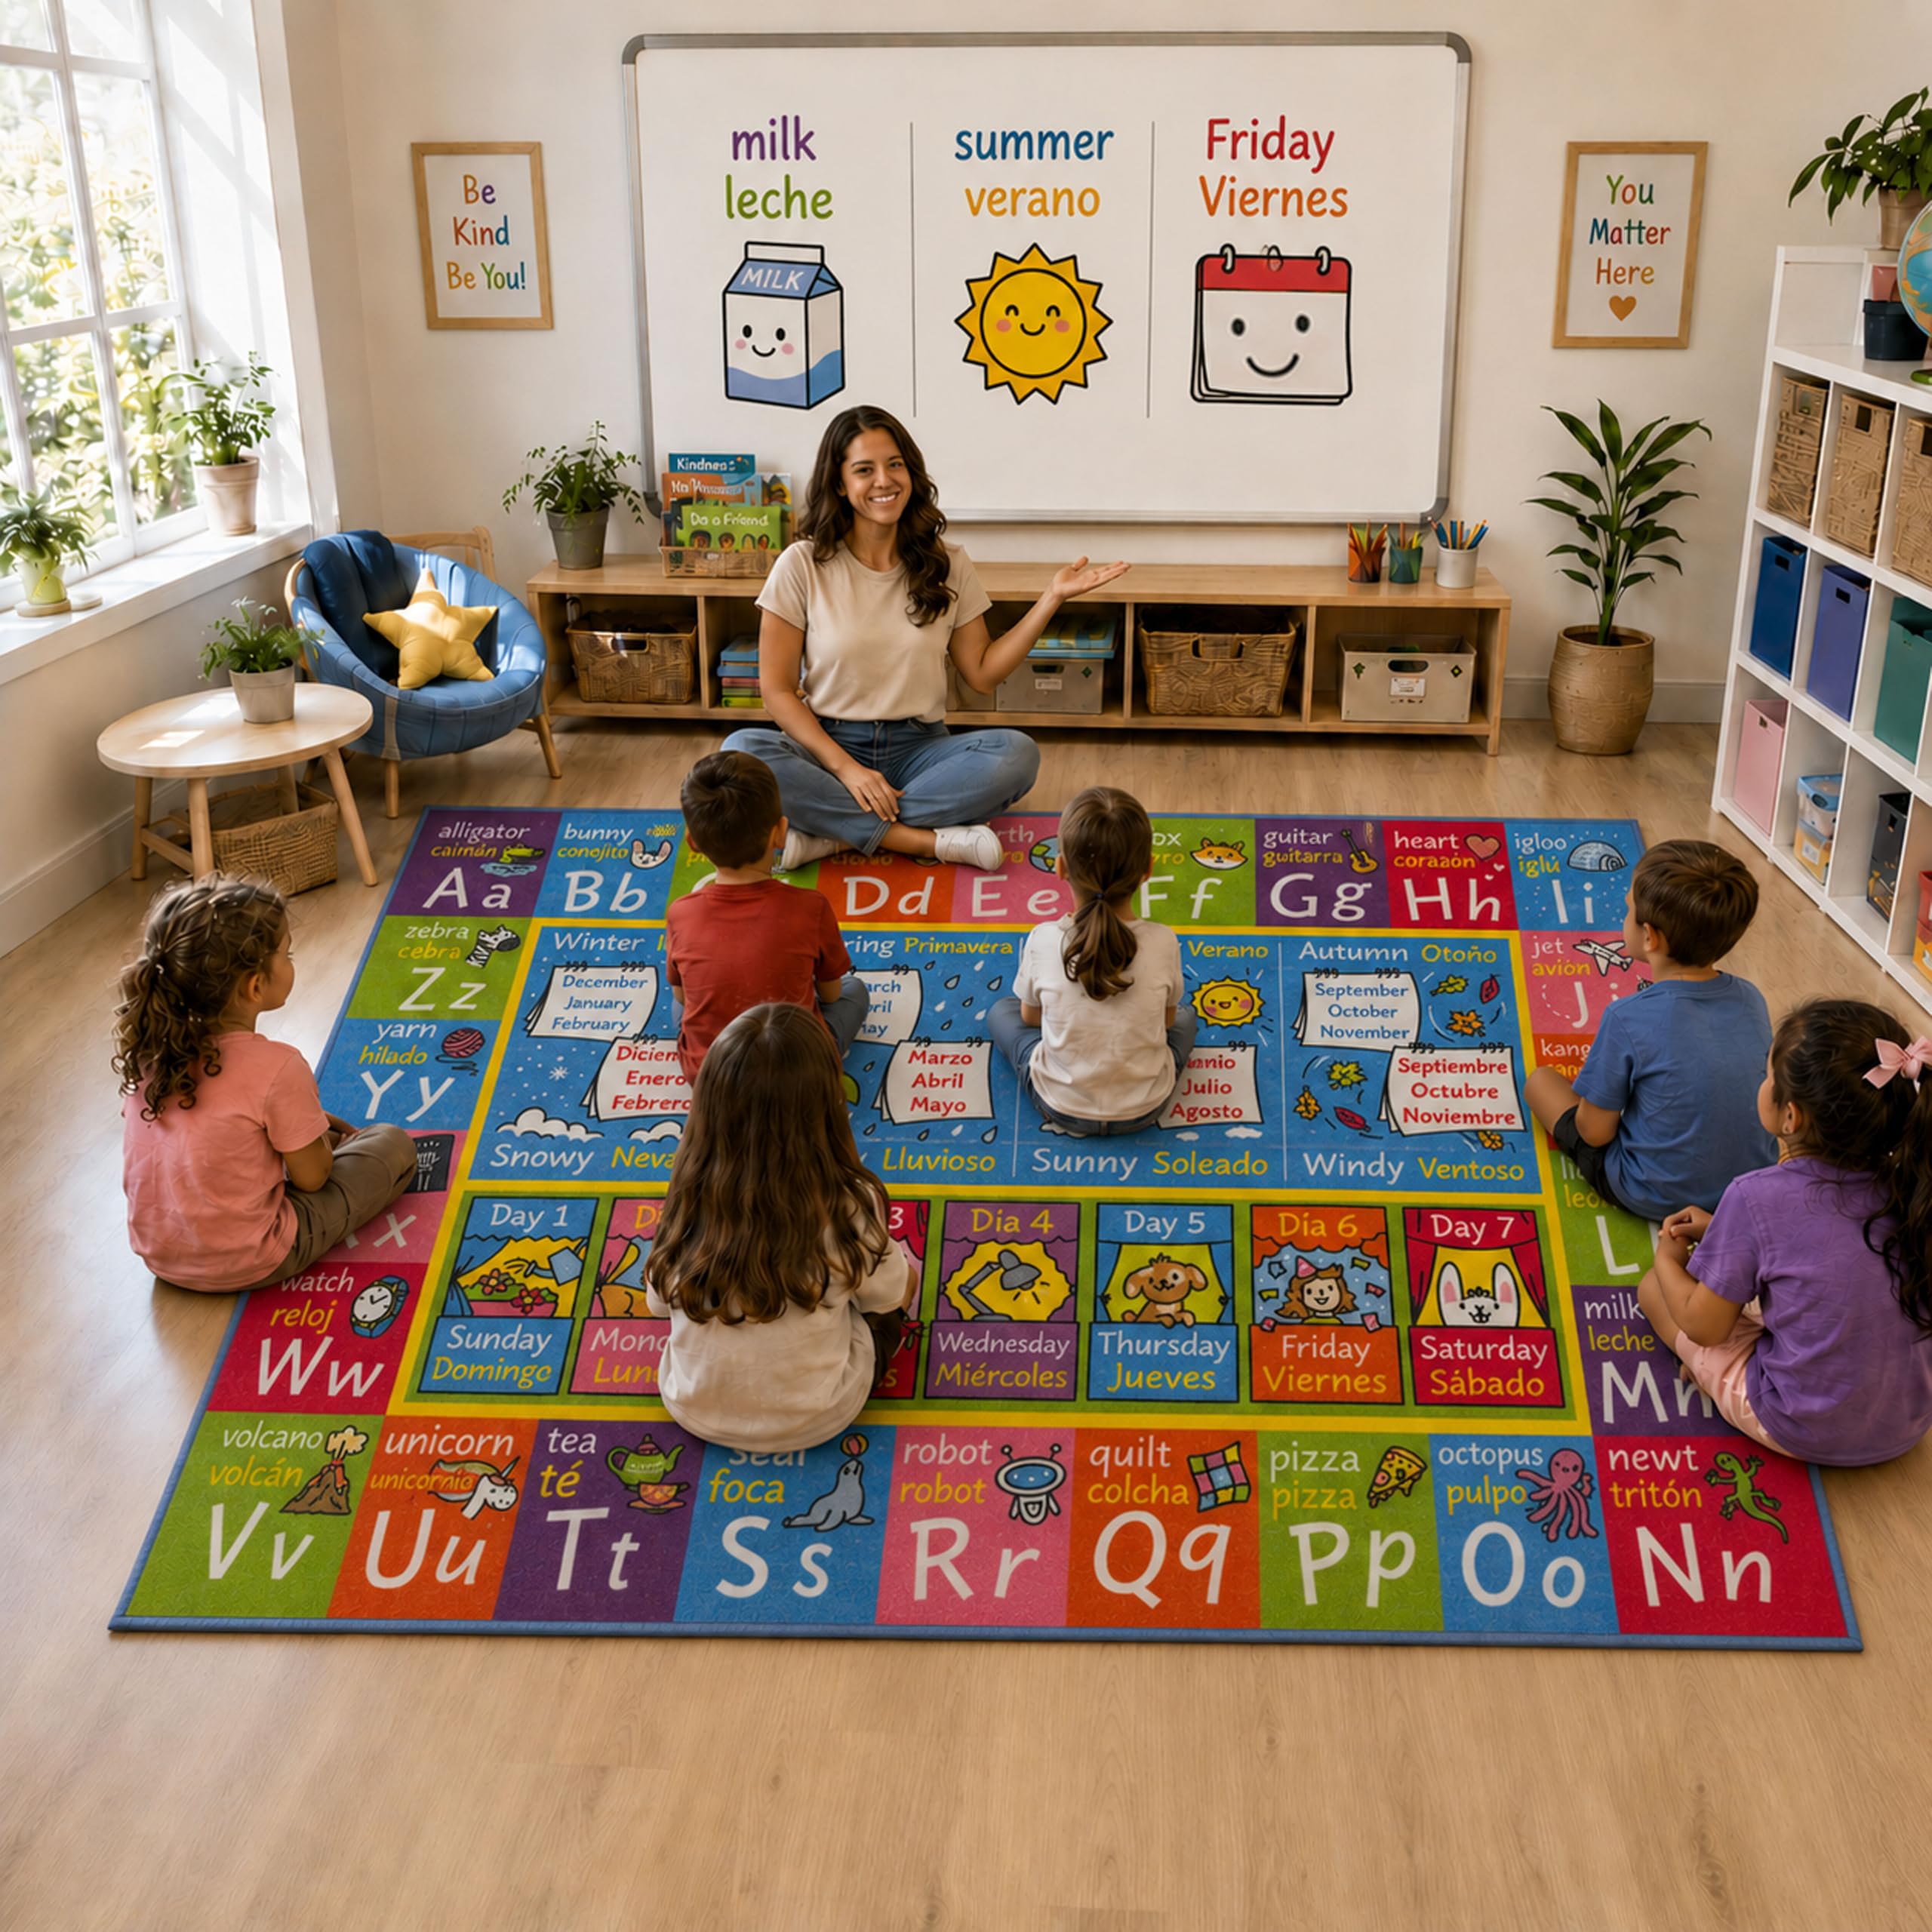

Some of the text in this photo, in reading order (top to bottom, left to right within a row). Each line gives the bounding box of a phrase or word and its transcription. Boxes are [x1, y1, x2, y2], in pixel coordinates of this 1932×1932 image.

[731, 115, 817, 161] milk
[955, 130, 1114, 160] summer
[1207, 115, 1334, 173] Friday
[463, 174, 496, 205] Be
[725, 174, 833, 220] leche
[964, 187, 1100, 217] verano
[1199, 175, 1348, 217] Viernes
[1606, 174, 1654, 205] You
[453, 214, 509, 245] Kind
[1589, 218, 1671, 245] Matter
[446, 261, 526, 290] Be You!
[740, 267, 804, 291] MILK
[1596, 257, 1654, 285] Here
[438, 822, 531, 843] alligator
[564, 823, 634, 846] bunny
[1263, 829, 1334, 848] guitar
[1394, 830, 1460, 850] heart
[1514, 832, 1567, 854] igloo
[430, 842, 497, 858] caimán
[1262, 848, 1343, 867] guitarra
[1518, 854, 1561, 878] iglú
[405, 921, 470, 940] zebra
[554, 931, 645, 952] Winter
[398, 941, 460, 959] cebra
[844, 936, 1013, 958] ring Primavera
[1188, 940, 1269, 958] Verano
[1298, 941, 1497, 963] Autumn Otoño
[1531, 935, 1564, 959] jet
[562, 974, 648, 989] December
[1532, 959, 1591, 977] avión
[868, 980, 901, 992] arch
[1315, 982, 1409, 1000] September
[564, 996, 632, 1013] January
[1327, 1004, 1398, 1018] October
[372, 1023, 438, 1044] yarn
[551, 1017, 630, 1033] February
[862, 1023, 888, 1038] ay
[1320, 1025, 1410, 1039] November
[358, 1044, 428, 1065] hilado
[908, 1050, 973, 1066] Marzo
[1398, 1057, 1507, 1078] Septiembre
[626, 1070, 685, 1086] Enero
[911, 1073, 964, 1088] Abril
[1182, 1078, 1232, 1096] Julio
[1411, 1082, 1499, 1100] Octubre
[611, 1094, 691, 1111] Febrero
[909, 1097, 967, 1117] Mayo
[1170, 1103, 1243, 1123] Agosto
[1402, 1107, 1515, 1125] Noviembre
[490, 1143, 675, 1176] Snowy Neva
[882, 1146, 995, 1171] Lluvioso
[1032, 1147, 1269, 1182] Sunny Soleado
[1303, 1151, 1524, 1185] Windy Ventoso
[1564, 1183, 1602, 1208] leo
[490, 1203, 568, 1233] Day 1
[888, 1207, 904, 1229] 3
[1029, 1209, 1054, 1235] 4
[1124, 1210, 1205, 1240] Day 5
[1337, 1214, 1358, 1238] 6
[1430, 1214, 1515, 1245] Day 7
[281, 1266, 355, 1293] watch
[269, 1299, 337, 1335] reloj
[1584, 1292, 1646, 1320] milk
[447, 1323, 553, 1358] Sunday
[590, 1327, 669, 1352] Mon
[937, 1331, 1070, 1360] Wednesday
[1097, 1330, 1231, 1364] Thursday
[1281, 1333, 1371, 1367] Friday
[1420, 1335, 1548, 1369] Saturday
[1588, 1326, 1655, 1352] leche
[594, 1357, 658, 1384] Lun
[935, 1361, 1068, 1388] Miércoles
[1106, 1362, 1217, 1392] Jueves
[1262, 1366, 1387, 1395] Viernes
[1429, 1367, 1545, 1397] Sábado
[223, 1420, 324, 1451] volcano
[384, 1424, 514, 1457] unicorn
[548, 1427, 597, 1454] tea
[903, 1433, 993, 1466] robot
[1089, 1435, 1171, 1478] quilt
[1270, 1441, 1361, 1483] pizza
[1438, 1442, 1544, 1475] octopus
[1608, 1444, 1699, 1472] newt
[210, 1455, 303, 1487] volcán
[540, 1460, 581, 1498] té
[709, 1467, 785, 1503] foca
[900, 1472, 986, 1504] robot
[1087, 1473, 1189, 1505] colcha
[1446, 1474, 1527, 1515] pulpo
[1609, 1478, 1703, 1509] tritón
[1272, 1480, 1358, 1521] pizza
